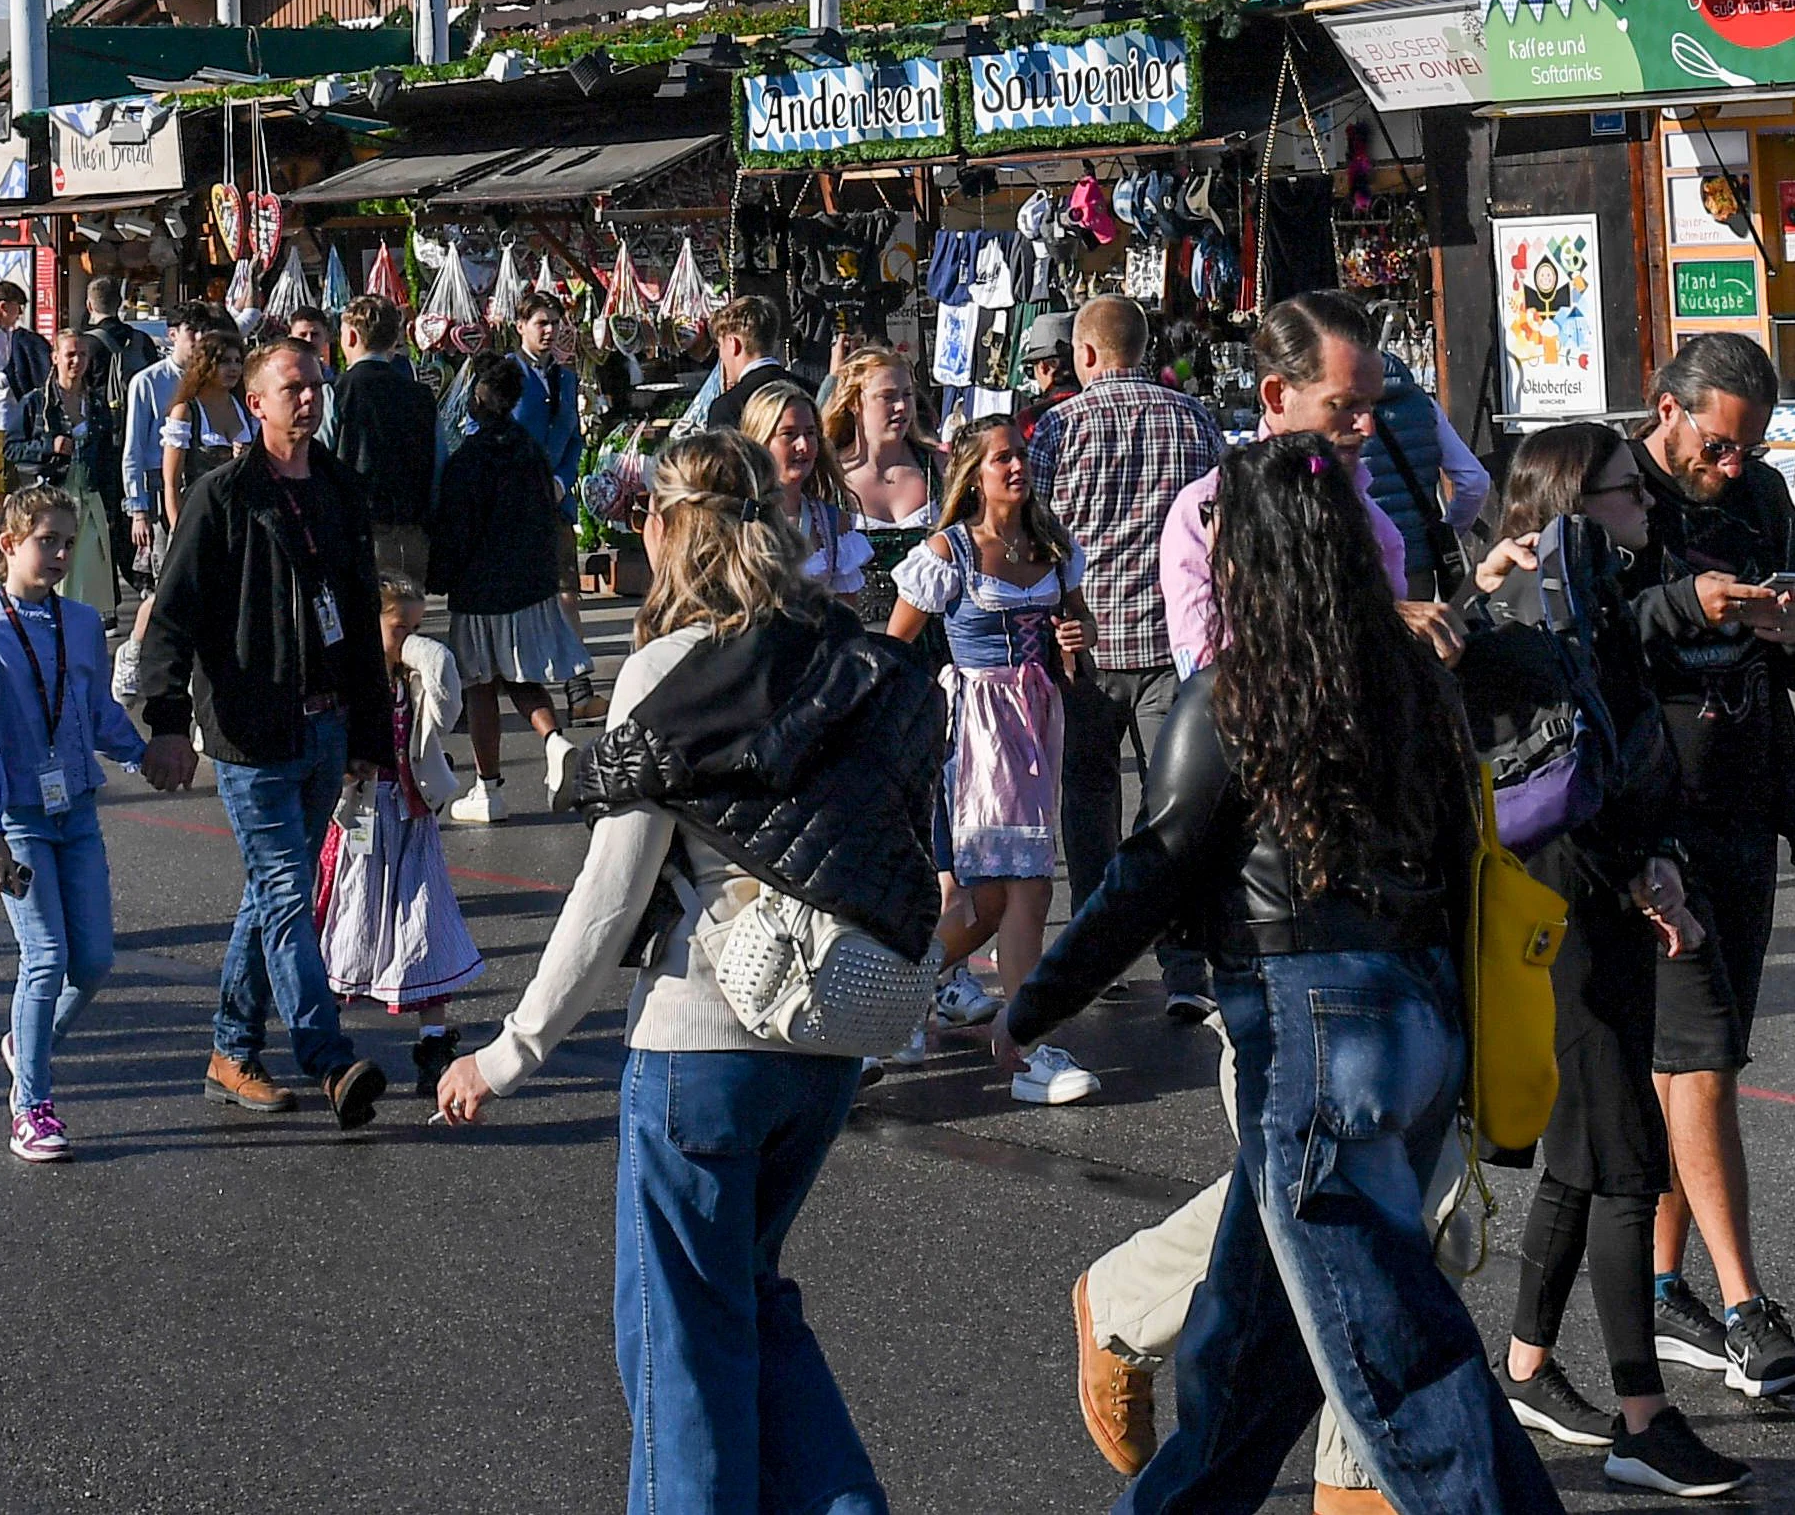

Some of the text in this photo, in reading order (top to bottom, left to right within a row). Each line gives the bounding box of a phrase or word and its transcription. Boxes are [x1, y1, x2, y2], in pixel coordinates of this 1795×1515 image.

[1712, 0, 1736, 17] süß
[1508, 34, 1587, 61] Kaffee und
[981, 47, 1181, 114] Souvenier
[1362, 57, 1484, 85] GEHT OIWEI
[1531, 62, 1603, 86] Softdrinks
[752, 78, 942, 139] Andenken
[1678, 271, 1717, 291] Pfand
[1679, 291, 1745, 313] Rückgabe
[1521, 379, 1584, 396] Oktoberfest
